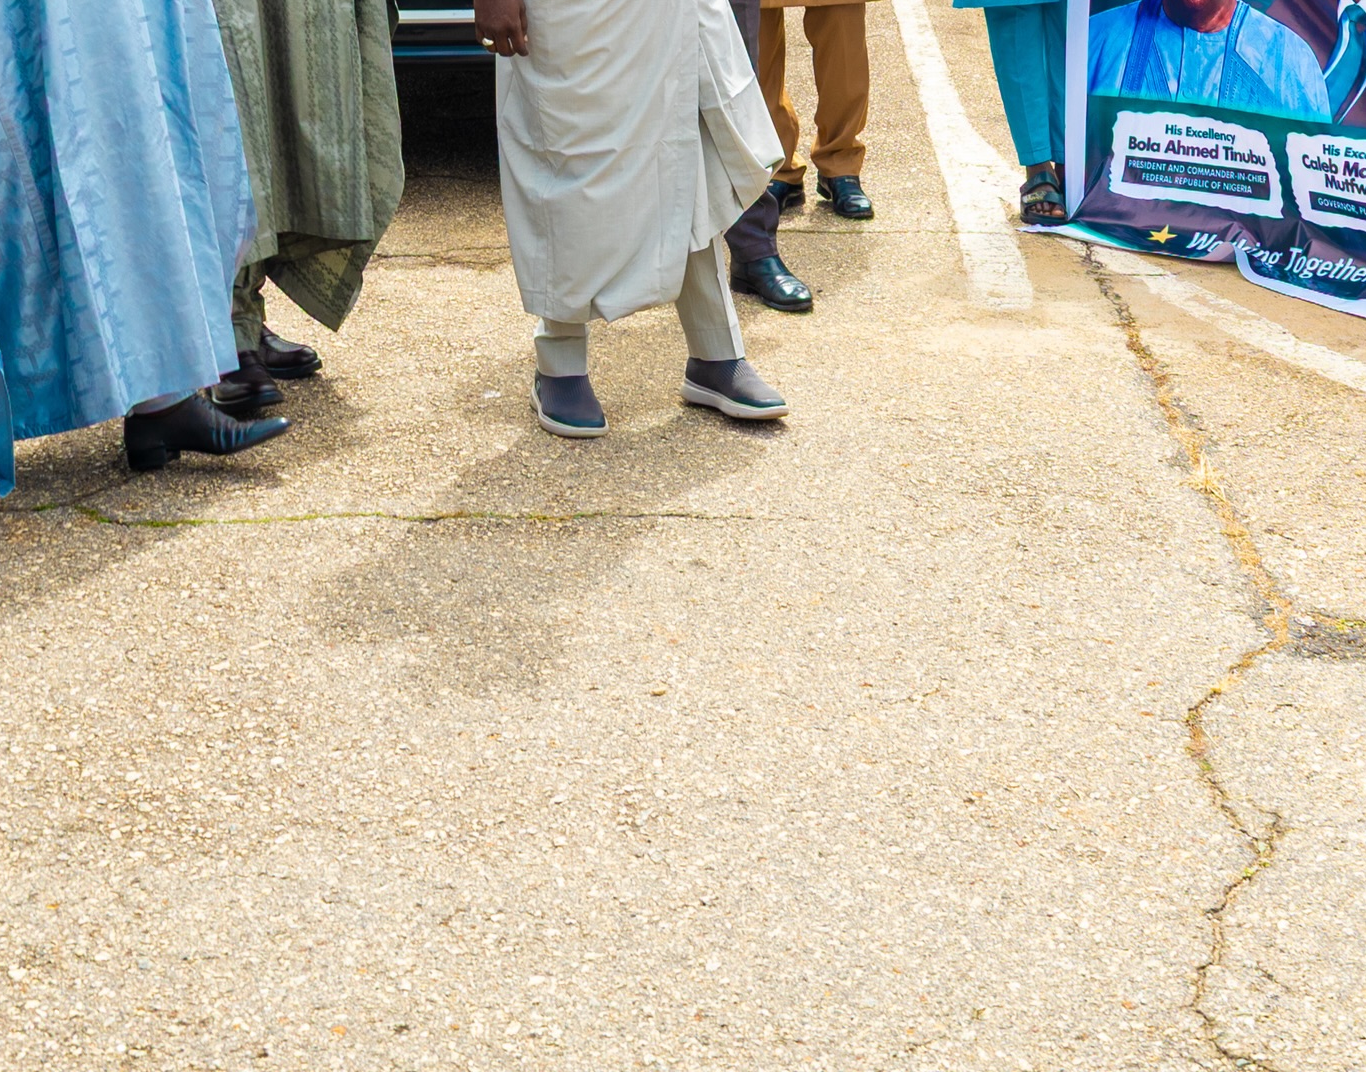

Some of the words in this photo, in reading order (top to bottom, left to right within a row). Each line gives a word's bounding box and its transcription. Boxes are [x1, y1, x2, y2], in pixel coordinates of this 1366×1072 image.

[1165, 124, 1182, 136] His
[1186, 126, 1235, 144] Excellency
[1128, 136, 1160, 152] Bola
[1164, 139, 1219, 160] Ahmed
[1223, 146, 1266, 166] Tinubu
[1323, 144, 1340, 156] His
[1128, 159, 1166, 171] PRESIDENT
[1168, 164, 1185, 173] AND
[1187, 166, 1266, 184] COMMANDER-IN-CHIEF
[1302, 155, 1338, 174] Caleb
[1142, 172, 1173, 183] FEDERAL
[1174, 177, 1209, 188] REPUBLIC
[1211, 181, 1221, 189] OF
[1223, 183, 1252, 194] NIGERIA
[1318, 198, 1358, 214] GOVERNOR,
[1185, 231, 1283, 268] Woking
